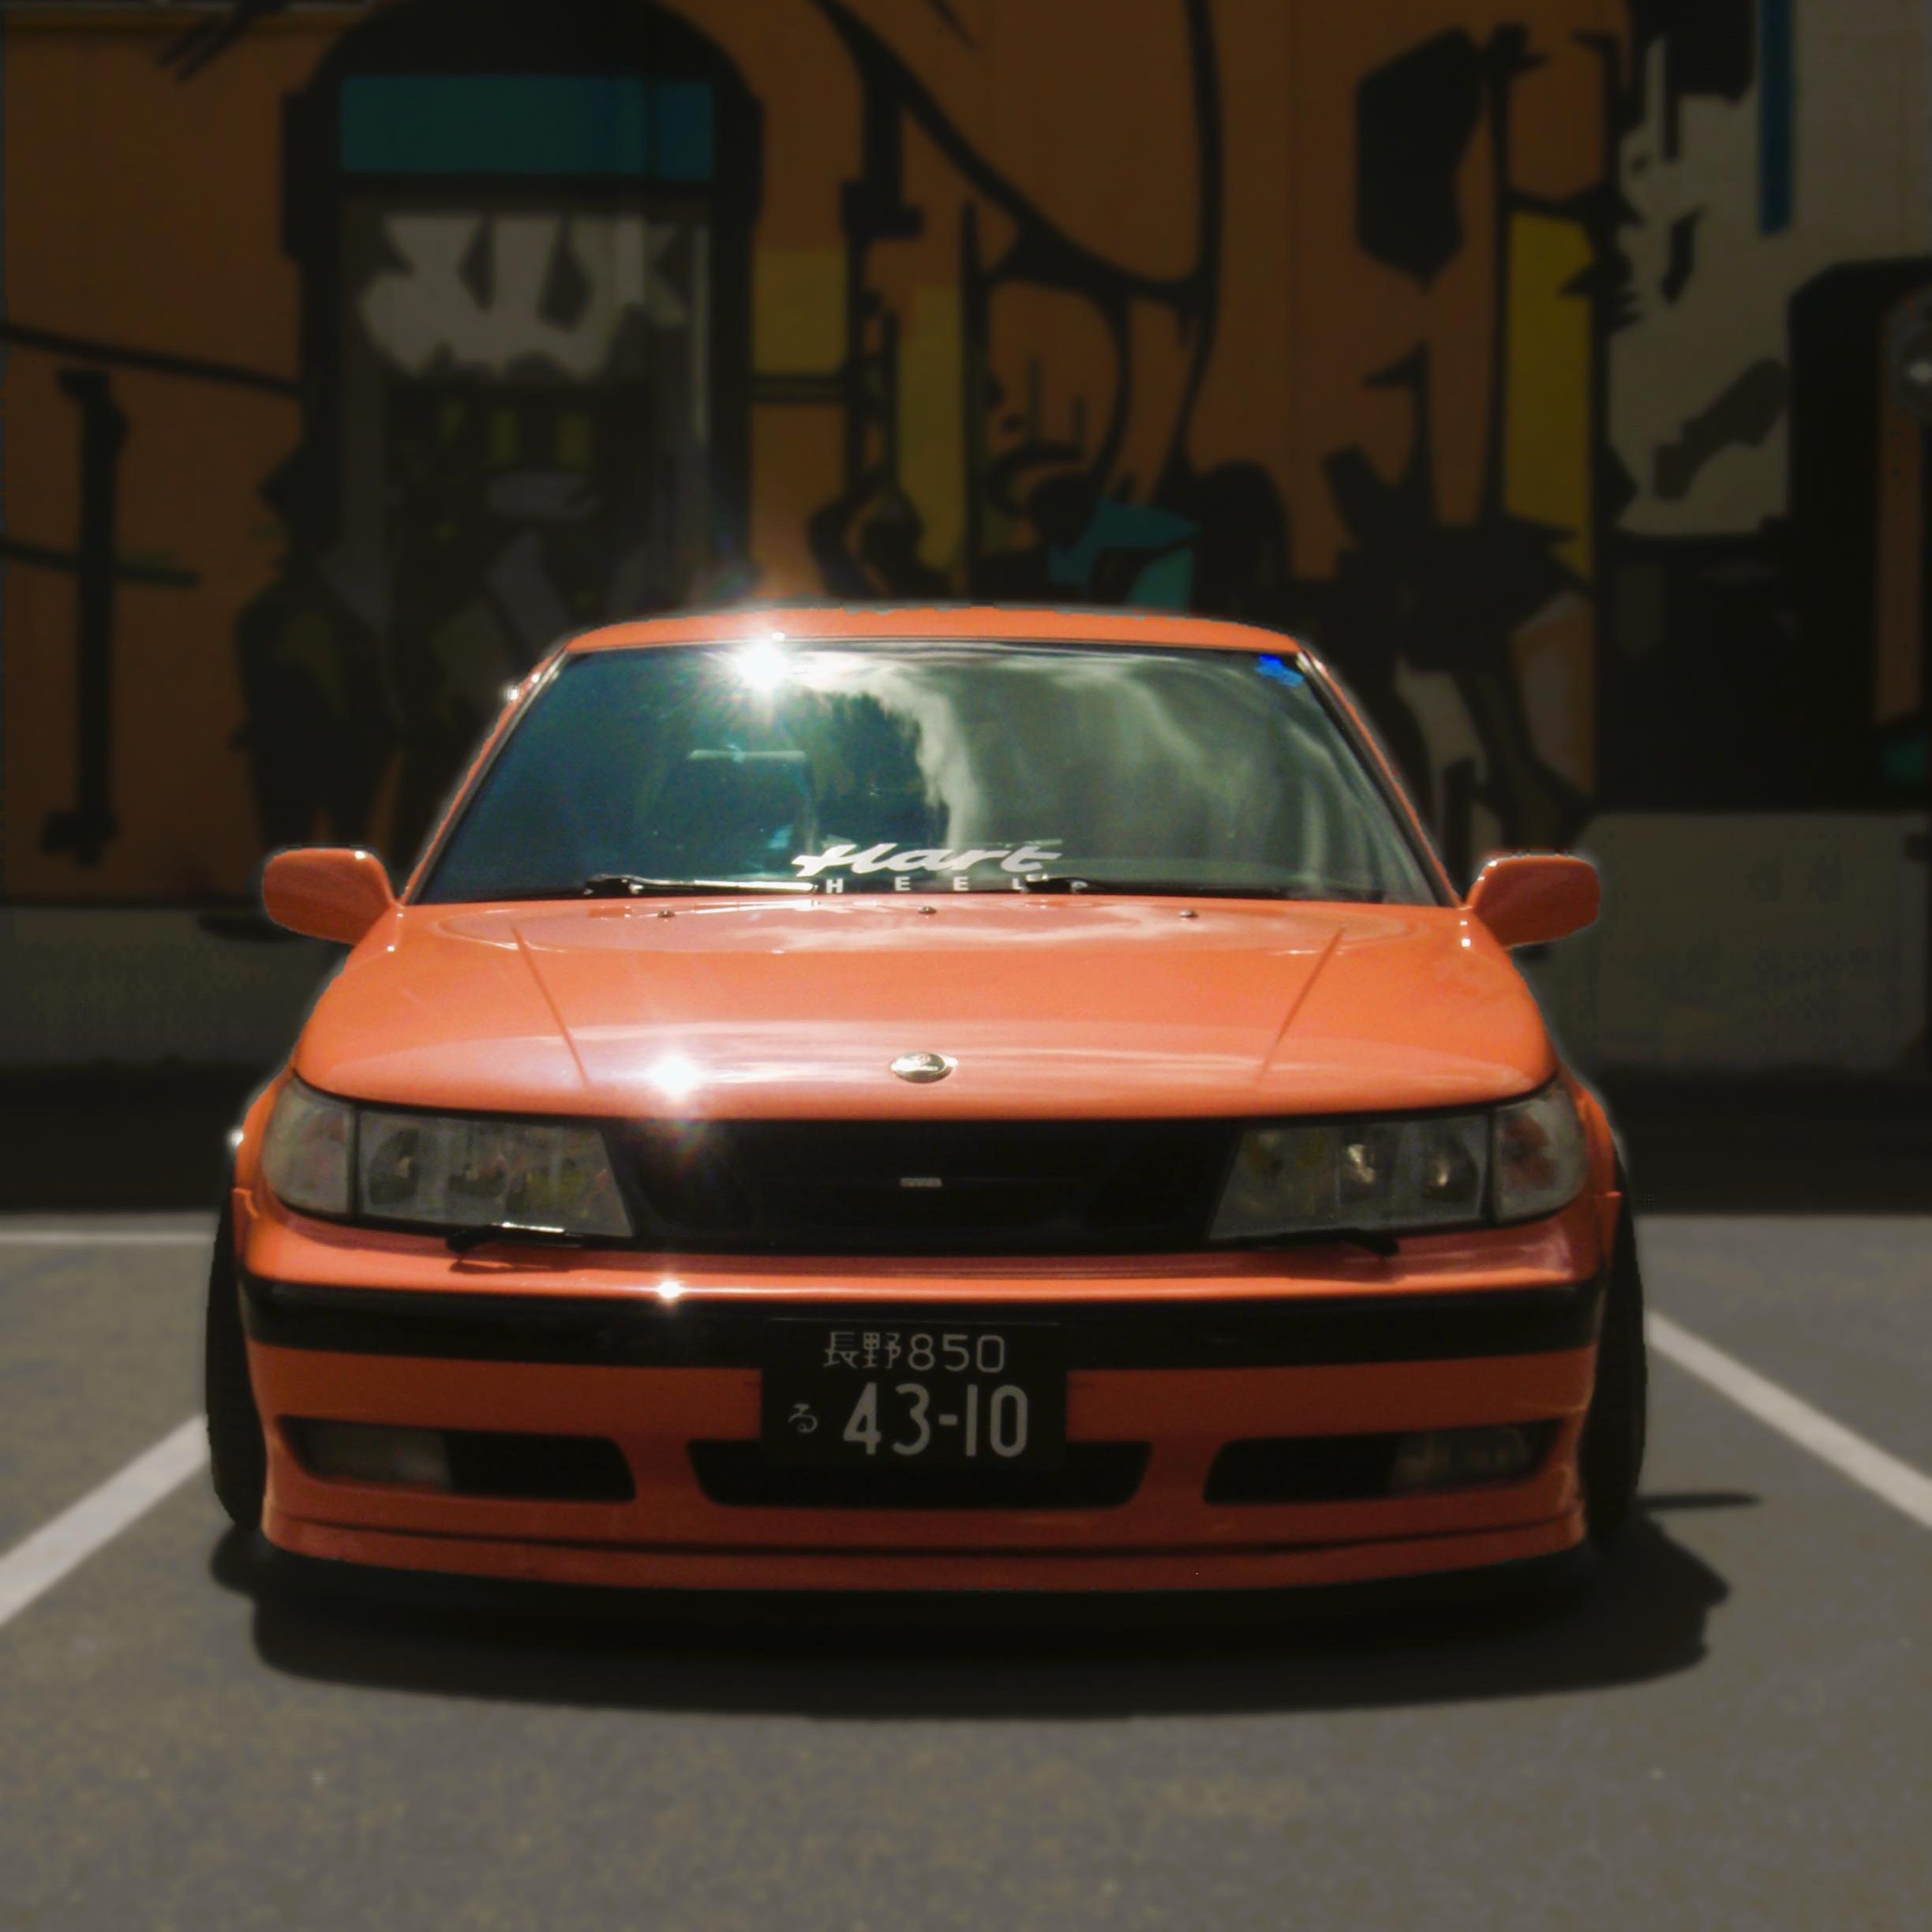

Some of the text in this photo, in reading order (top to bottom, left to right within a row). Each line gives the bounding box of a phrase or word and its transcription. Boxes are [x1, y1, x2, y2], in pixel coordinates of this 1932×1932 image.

[792, 842, 1062, 878] Hart
[823, 1331, 1005, 1373] 長野850
[788, 1382, 1029, 1458] る 43-10
